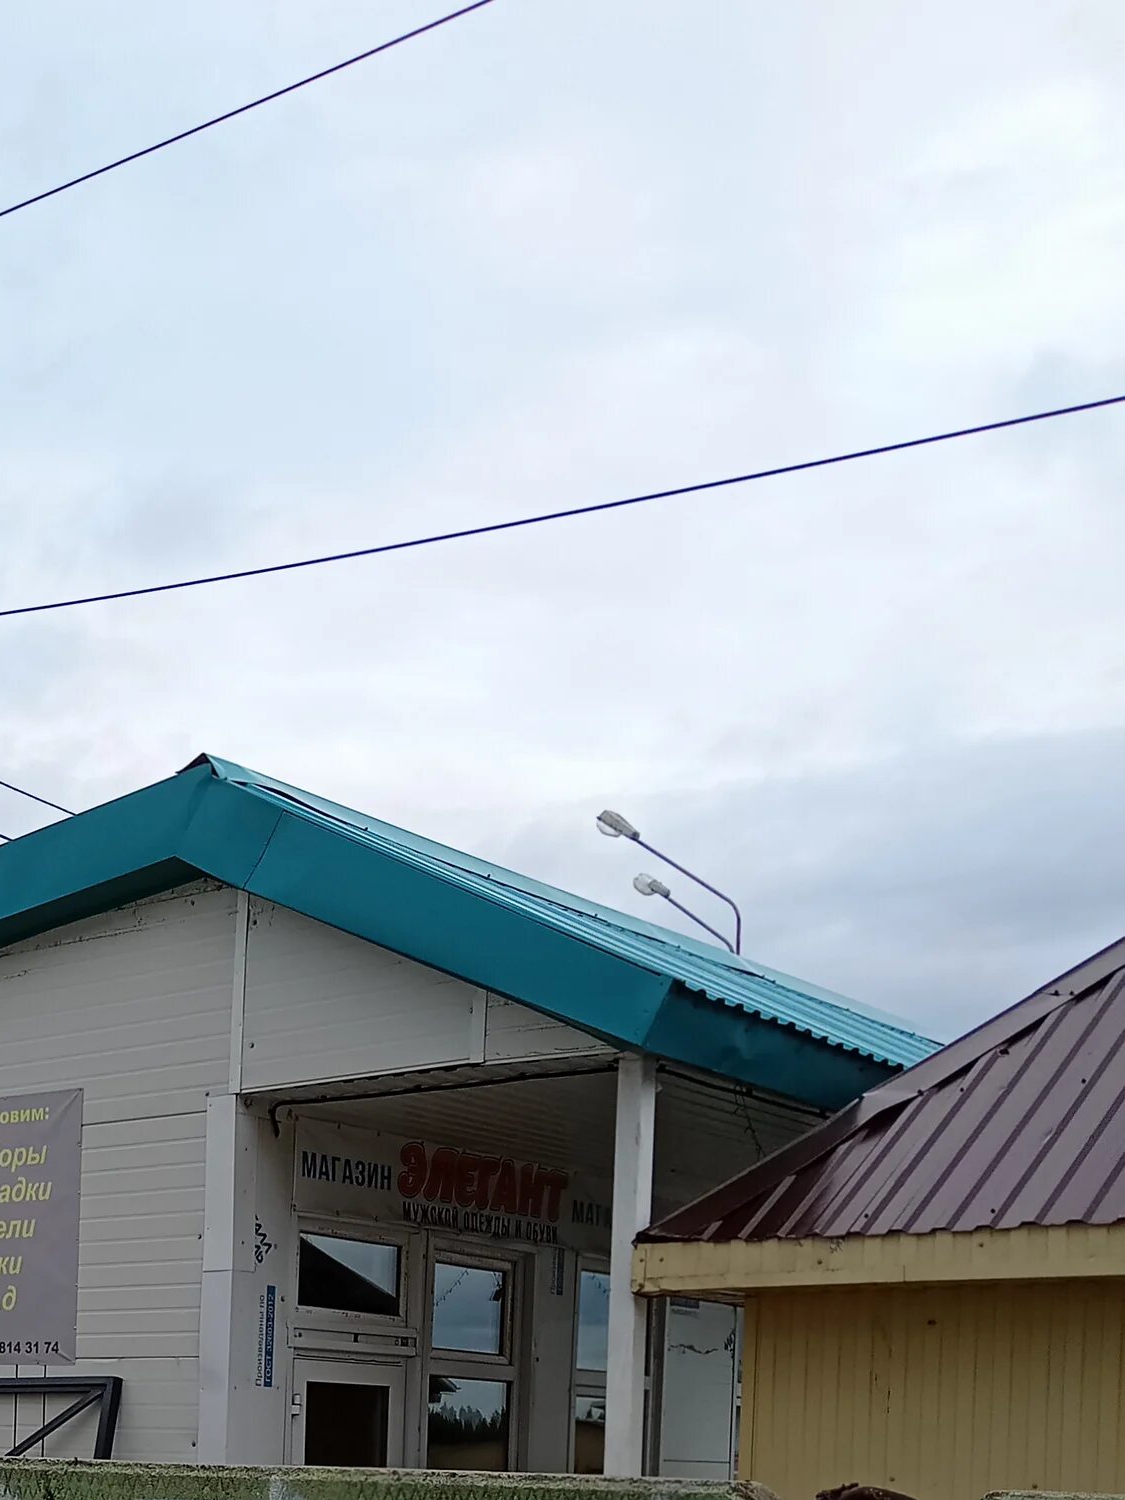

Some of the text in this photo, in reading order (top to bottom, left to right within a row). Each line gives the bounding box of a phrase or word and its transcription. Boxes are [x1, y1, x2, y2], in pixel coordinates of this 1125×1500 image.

[301, 1140, 570, 1223] МАГАЗИН ЭЛЕГАНТ
[463, 1211, 511, 1241] ОДЕЖДЫ
[515, 1219, 523, 1239] И
[25, 1341, 40, 1354] 31
[44, 1341, 59, 1354] 74
[264, 1354, 272, 1383] ГОСТ
